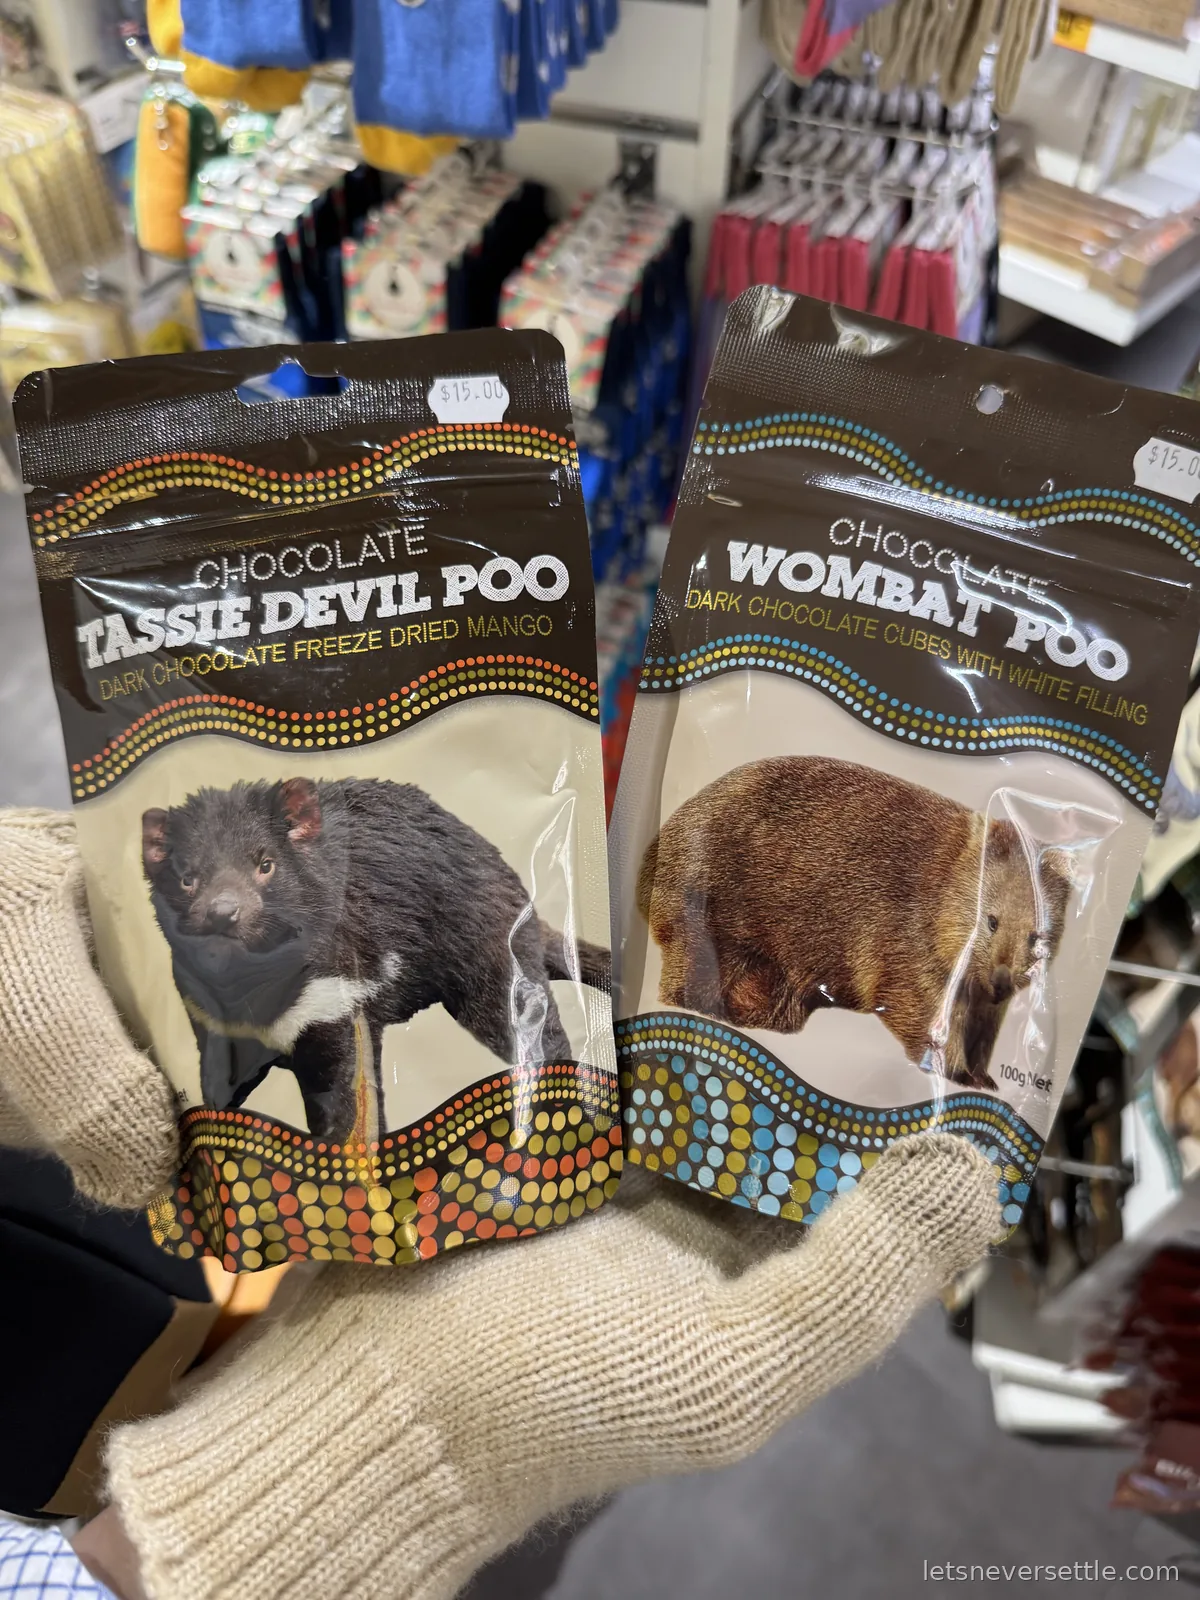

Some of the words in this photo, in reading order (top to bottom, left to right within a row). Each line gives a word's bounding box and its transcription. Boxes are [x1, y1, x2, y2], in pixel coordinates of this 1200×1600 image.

[441, 380, 503, 403] $15.00
[1147, 445, 1200, 480] $15.0
[194, 524, 428, 590] CHOCOLATE
[829, 517, 1050, 605] CHOCOLATE
[77, 596, 251, 670] TASSIE
[260, 572, 432, 634] DEVIL
[441, 554, 570, 607] POO
[727, 540, 992, 638] WOMBAT
[1005, 611, 1129, 682] POO
[100, 668, 150, 700] DARK
[152, 643, 287, 686] CHOCOLATE
[294, 630, 383, 660] FREEZE
[389, 619, 459, 648] DRIED
[467, 614, 553, 638] MANGO
[686, 589, 742, 613] DARK
[748, 596, 880, 640] CHOCOLATE
[883, 623, 952, 660] CUBES
[957, 645, 1004, 680] WITH
[1009, 663, 1074, 701] WHITE
[1075, 685, 1149, 726] FILLING
